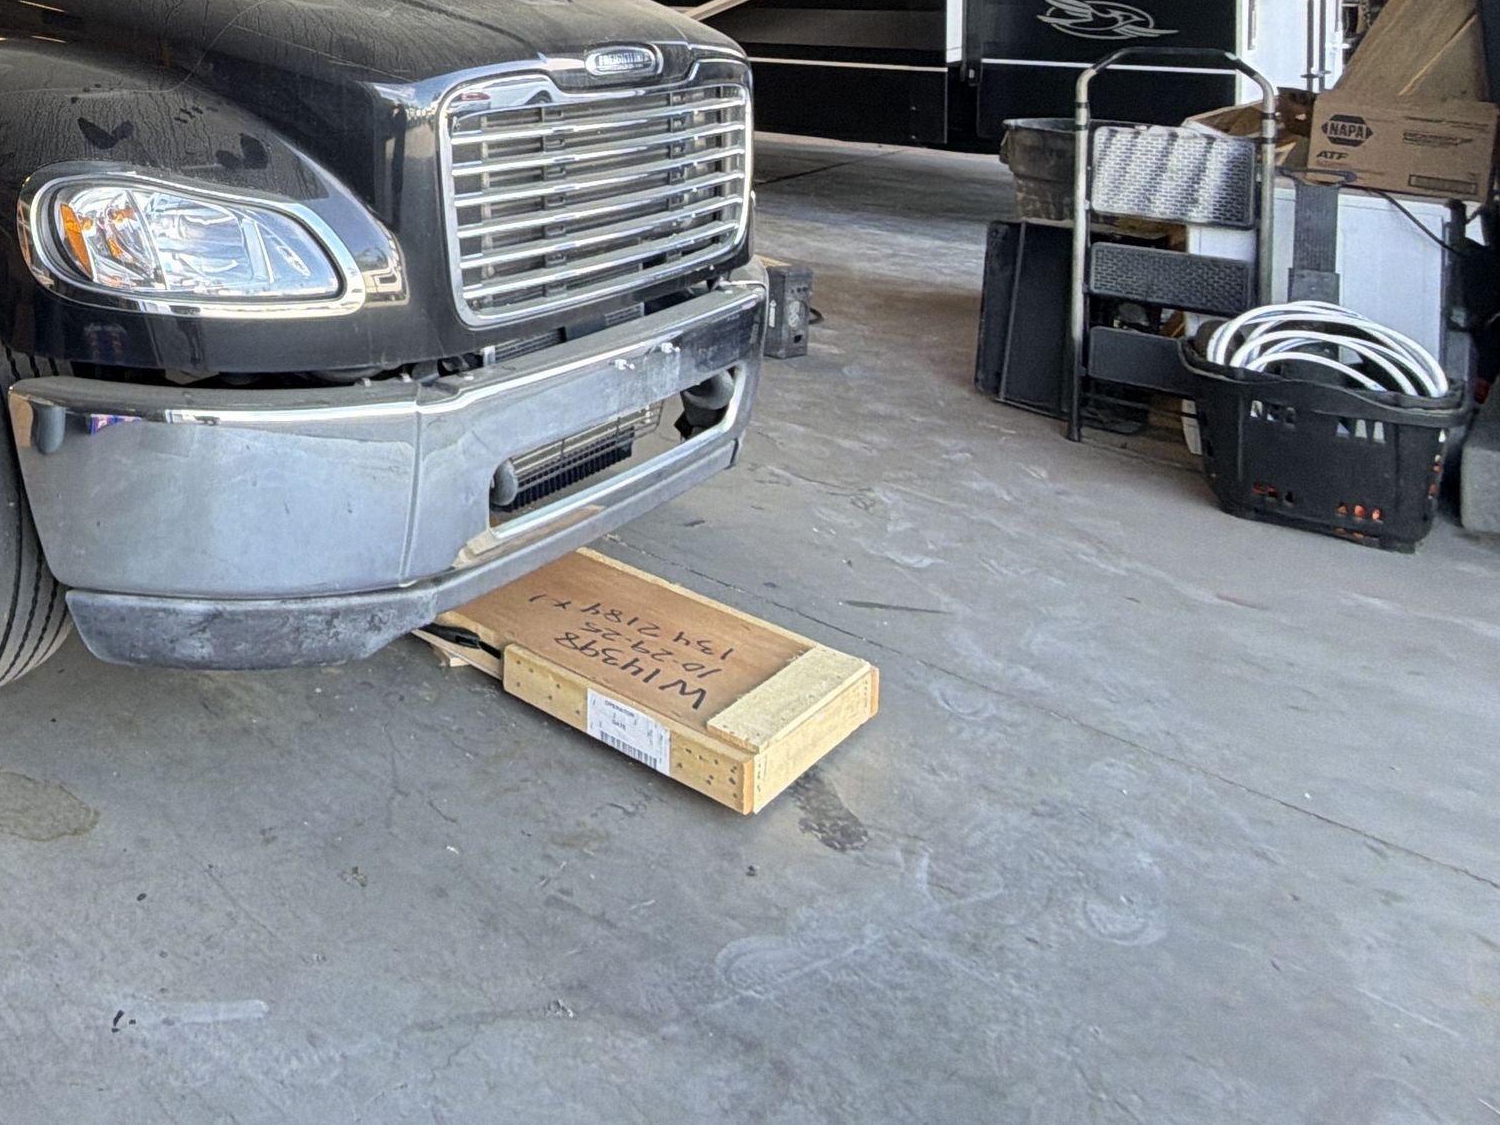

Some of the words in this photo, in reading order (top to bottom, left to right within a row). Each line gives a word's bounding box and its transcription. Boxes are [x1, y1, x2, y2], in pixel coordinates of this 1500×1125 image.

[1329, 122, 1366, 140] NAPA
[1316, 150, 1349, 161] ATF
[579, 622, 722, 679] 10-29-25
[554, 631, 707, 710] W14398
[604, 699, 635, 717] OPERATOR
